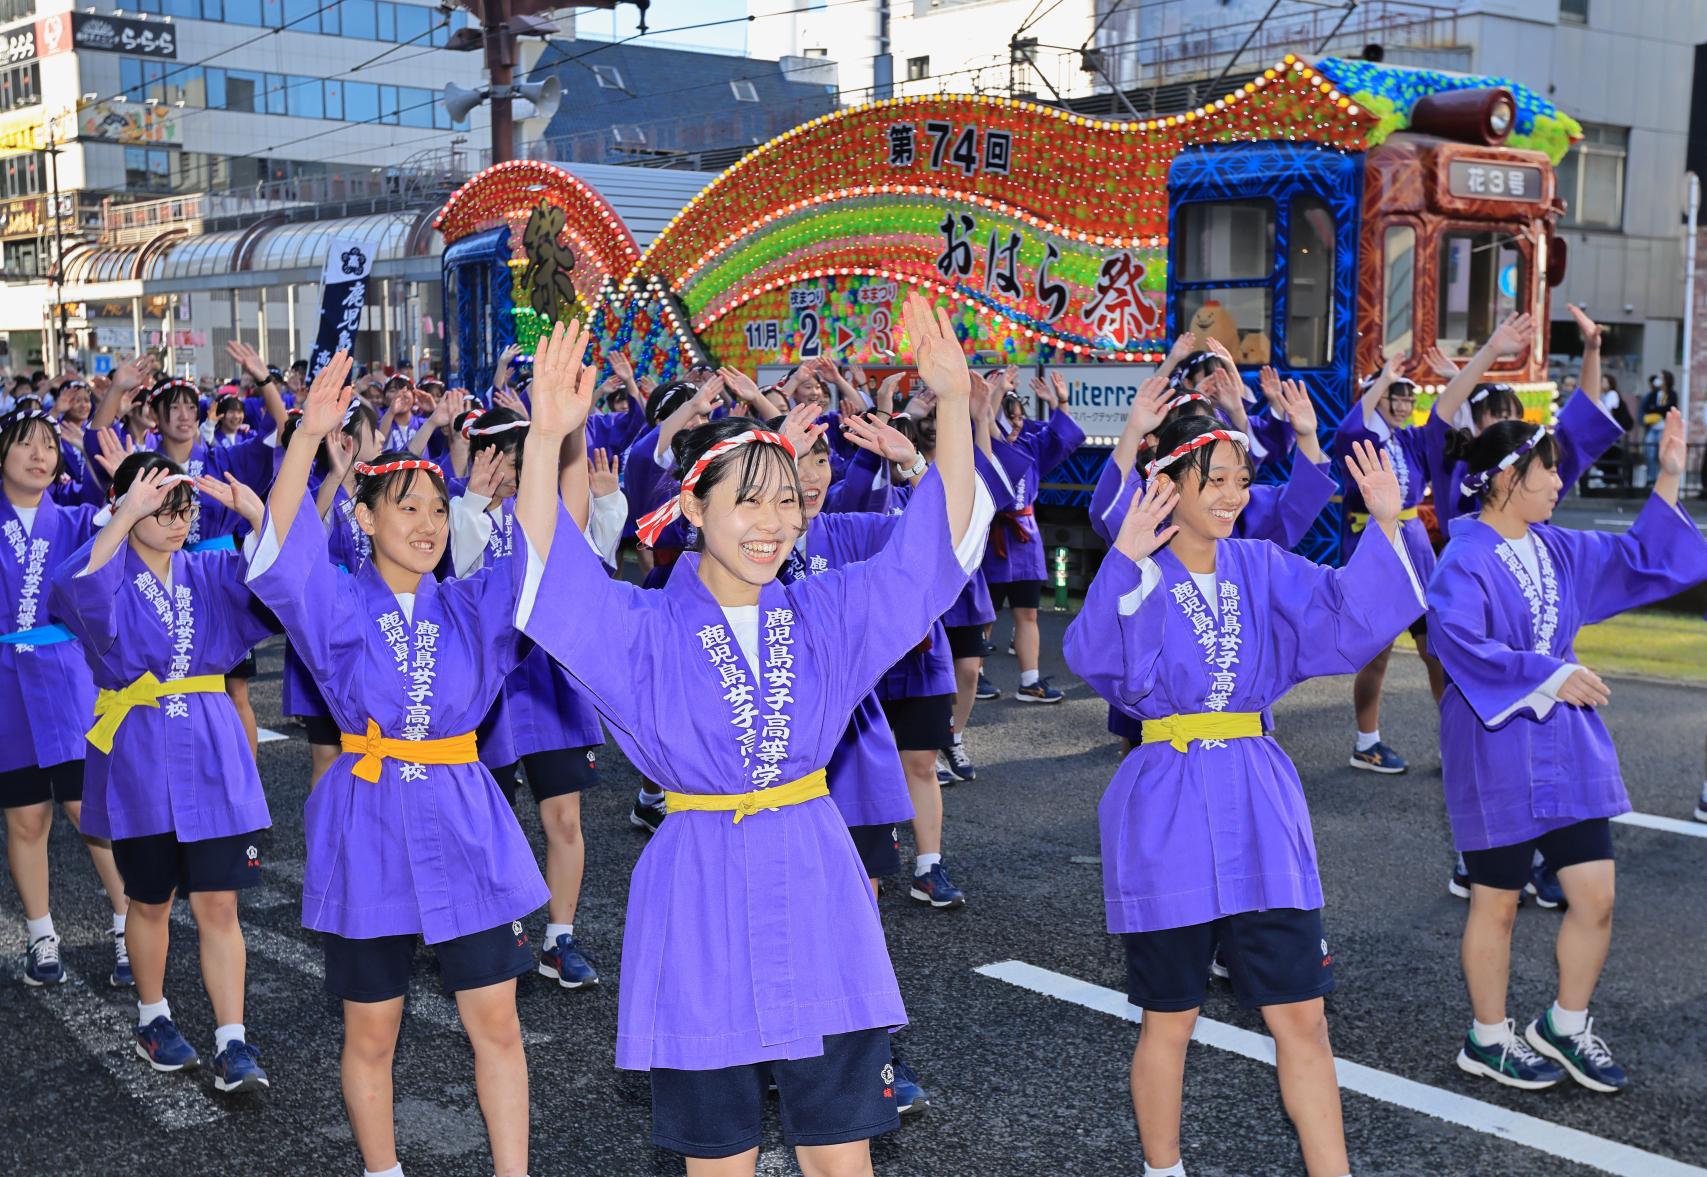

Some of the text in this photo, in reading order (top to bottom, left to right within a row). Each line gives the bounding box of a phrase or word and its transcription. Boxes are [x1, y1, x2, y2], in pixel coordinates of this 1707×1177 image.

[889, 122, 1012, 175] 第74回
[1468, 167, 1525, 195] 花3号
[745, 310, 892, 357] 11月 2 3
[936, 212, 1159, 349] おはら祭
[2, 519, 27, 565] 鹿児島
[399, 619, 441, 783] 鹿児島女子高等校
[695, 623, 760, 777] 鹿児島女子高
[749, 607, 796, 812] 鹿児島女子高等学
[1199, 580, 1243, 751] 鹿児島女子高等校
